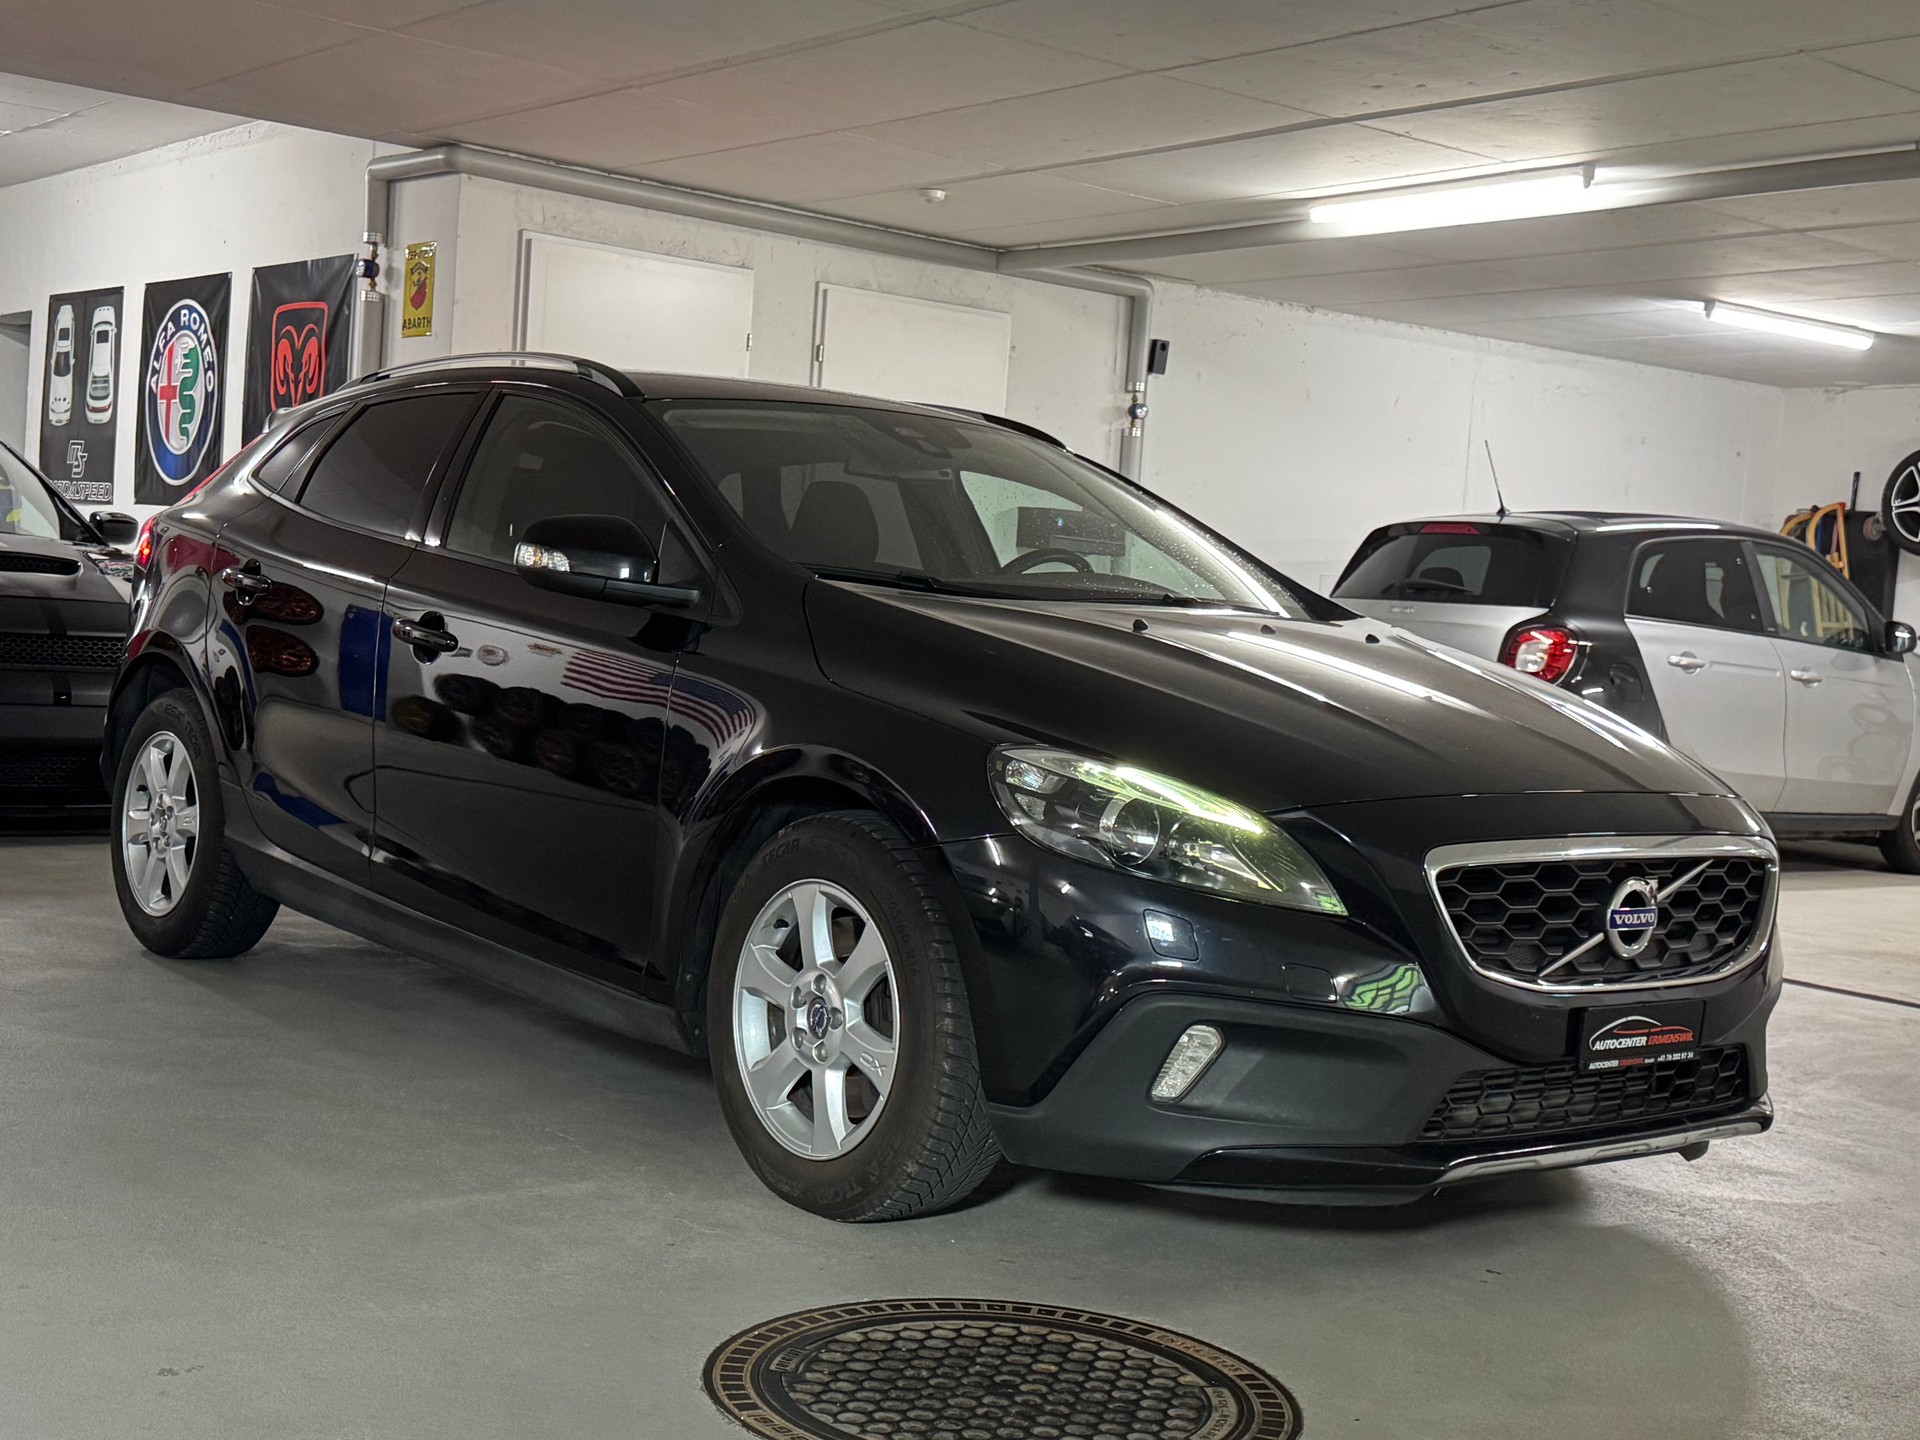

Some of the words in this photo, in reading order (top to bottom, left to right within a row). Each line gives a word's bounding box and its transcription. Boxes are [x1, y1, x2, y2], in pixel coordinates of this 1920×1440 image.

[402, 316, 432, 331] ABARTH
[151, 321, 176, 394] ALFA
[180, 309, 214, 392] ROMEO
[50, 480, 112, 502] ZDASPEED
[1613, 913, 1655, 925] VOLVO
[1593, 1037, 1647, 1051] AUTOCENTER
[1588, 1060, 1619, 1070] AUTOCENTER
